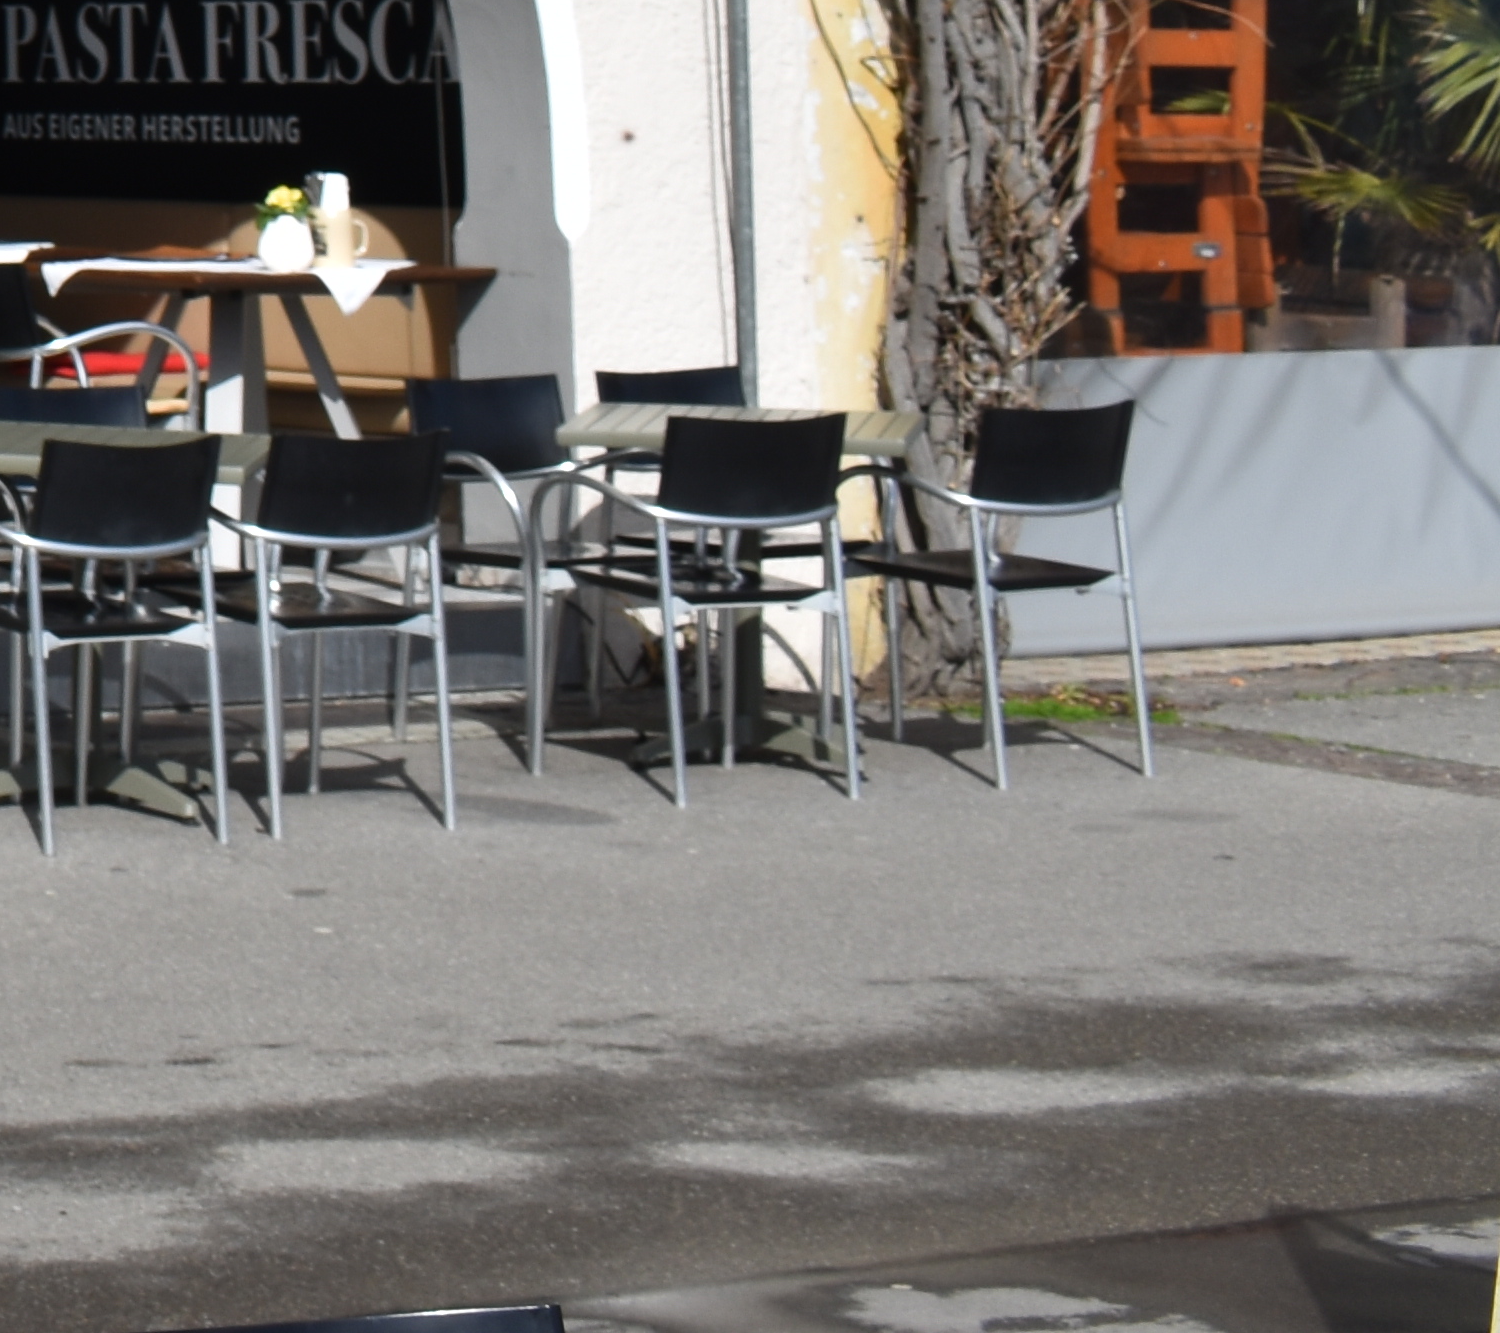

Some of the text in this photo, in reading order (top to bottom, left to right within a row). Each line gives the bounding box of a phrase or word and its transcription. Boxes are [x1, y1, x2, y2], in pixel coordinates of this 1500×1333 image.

[2, 2, 192, 84] PASTA
[3, 114, 301, 144] AUS EIGENER HERSTELLUNG
